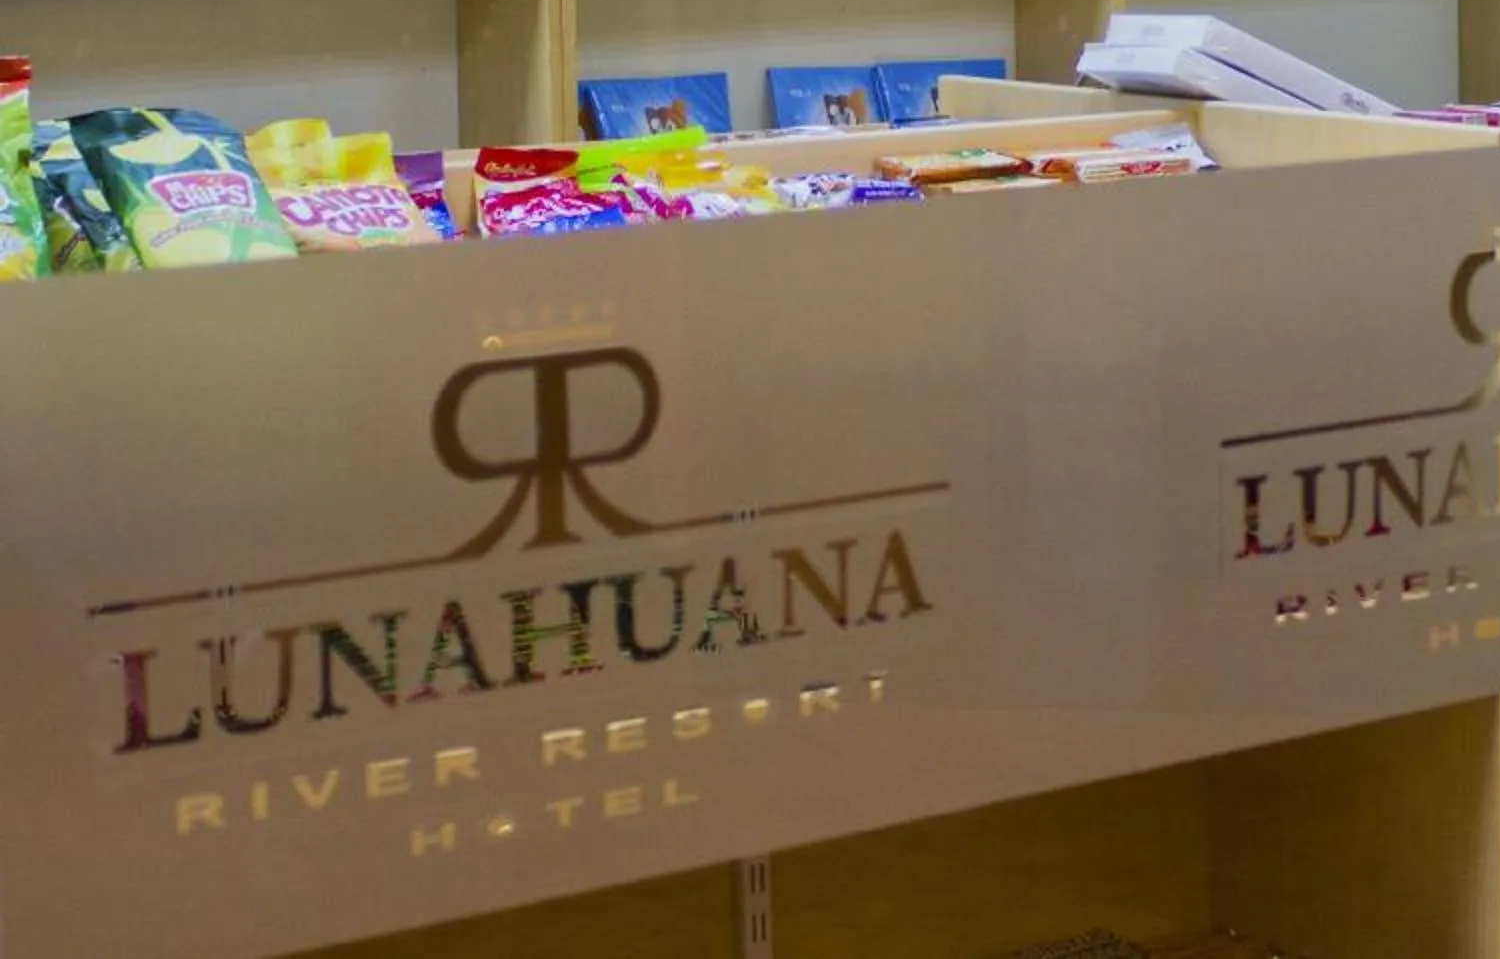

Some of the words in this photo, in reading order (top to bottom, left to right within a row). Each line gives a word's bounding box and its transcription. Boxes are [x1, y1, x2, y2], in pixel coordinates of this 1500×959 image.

[1273, 564, 1480, 625] RIVER
[111, 530, 935, 755] LUNAHUANA
[173, 744, 480, 836] RIVER
